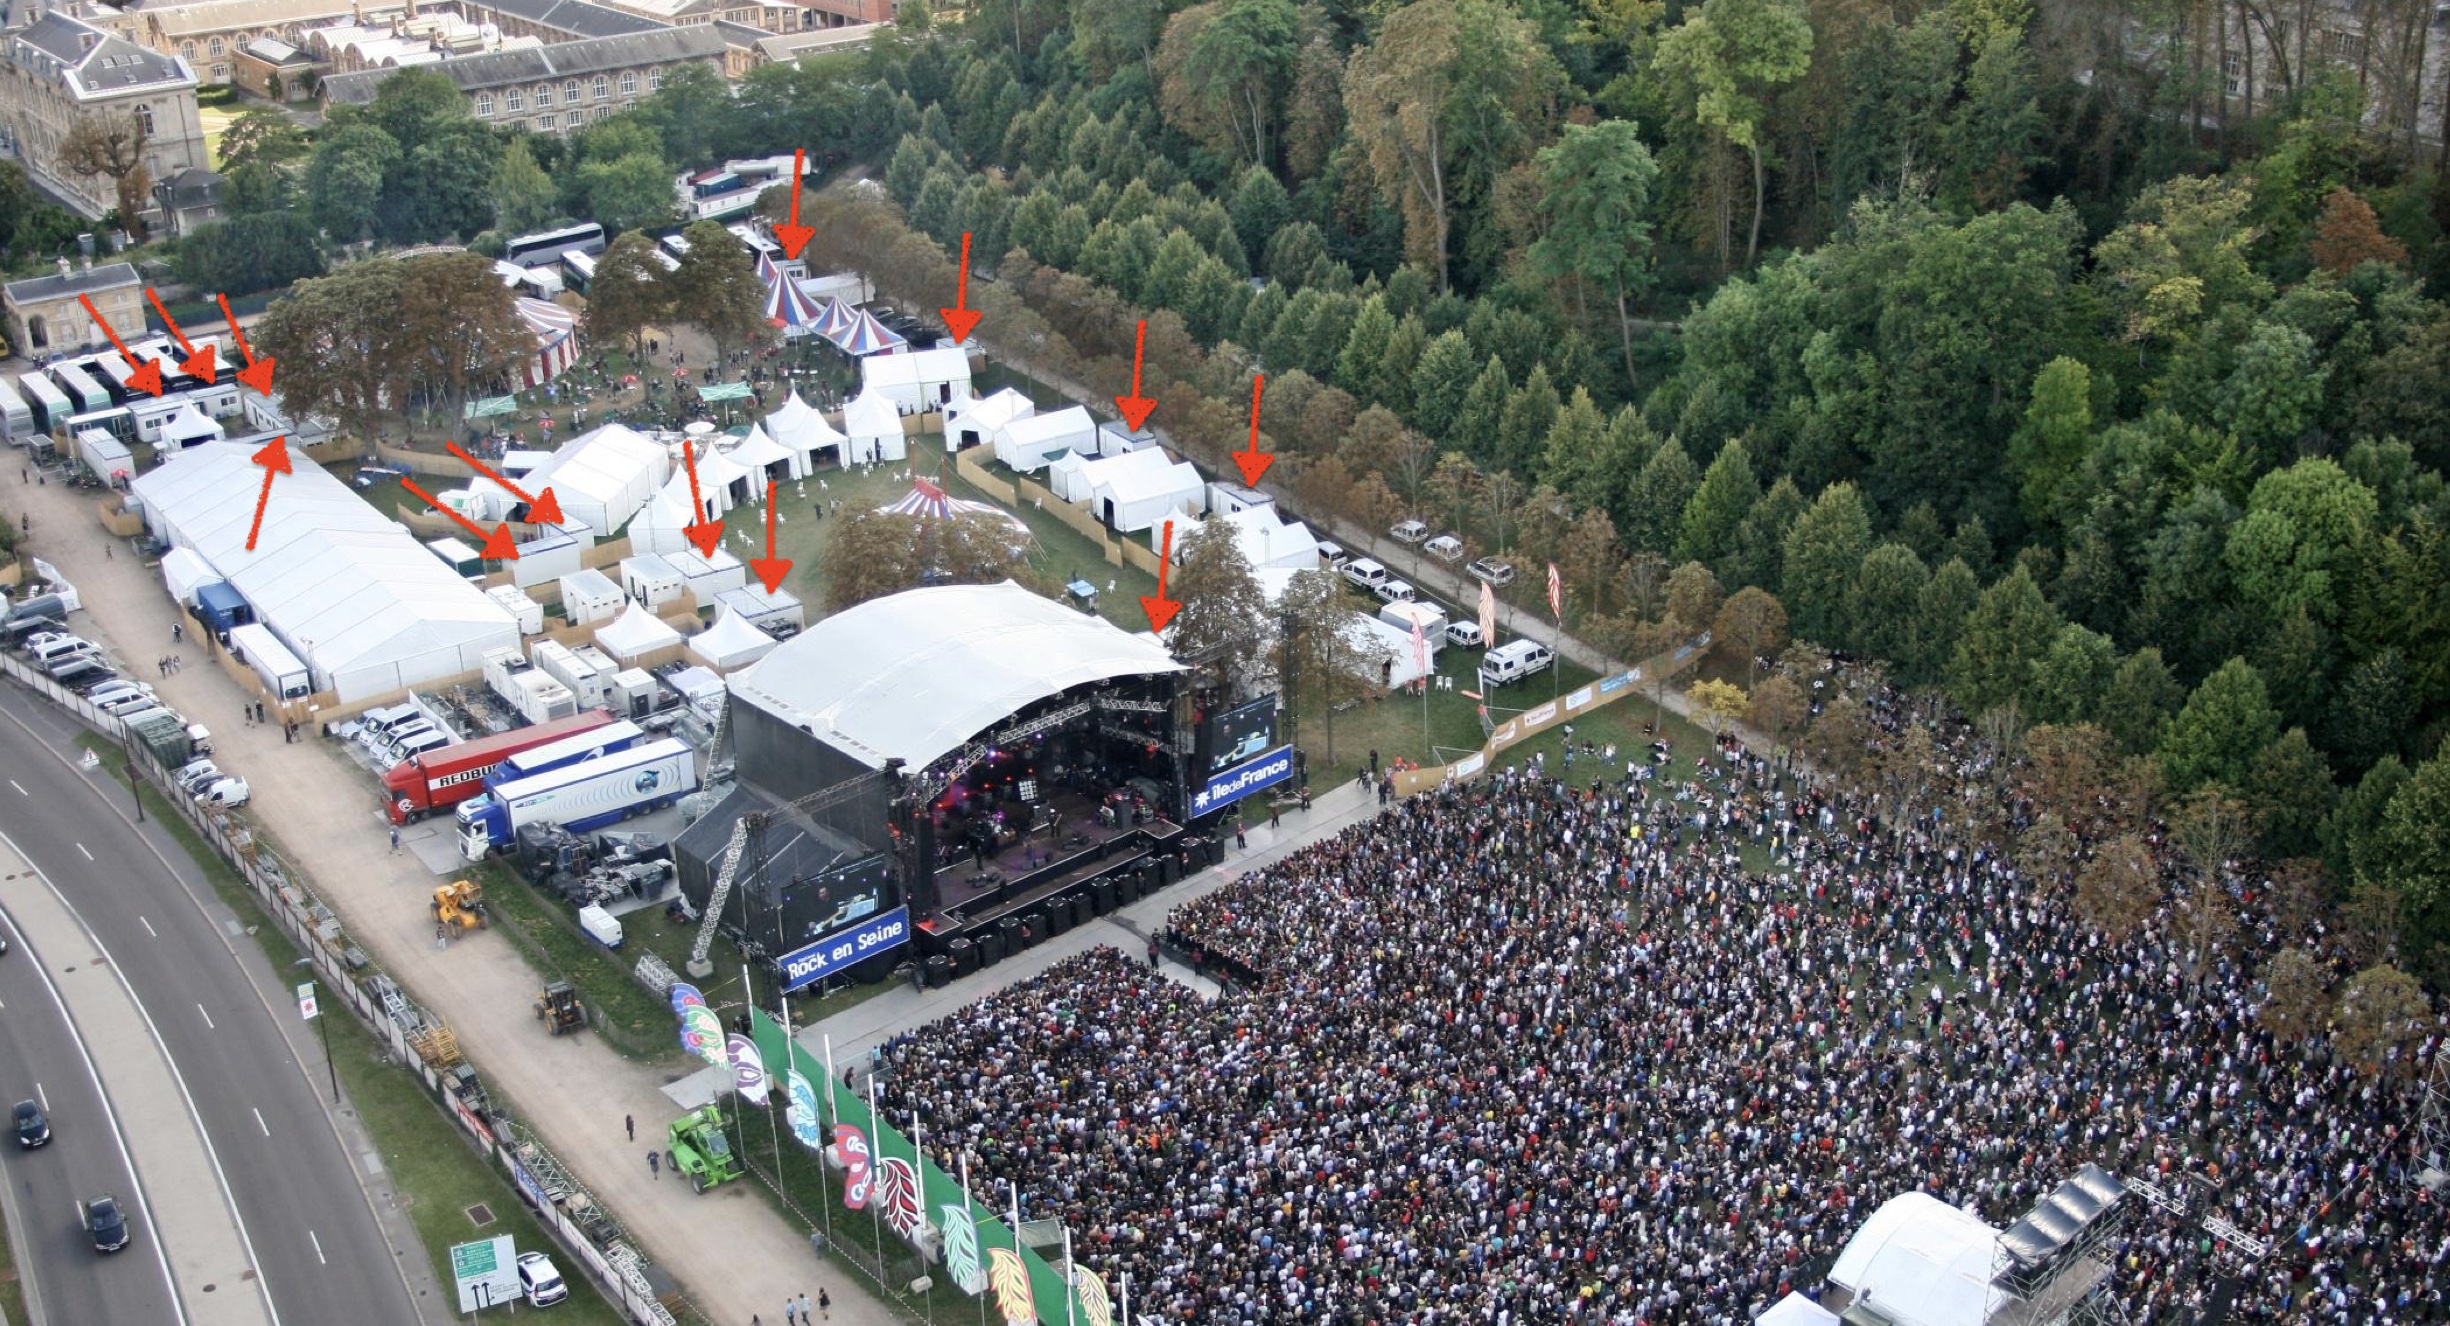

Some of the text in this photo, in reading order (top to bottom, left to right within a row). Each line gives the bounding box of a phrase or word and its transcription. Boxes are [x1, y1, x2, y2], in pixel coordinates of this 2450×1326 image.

[787, 921, 903, 980] Rock en Seine
